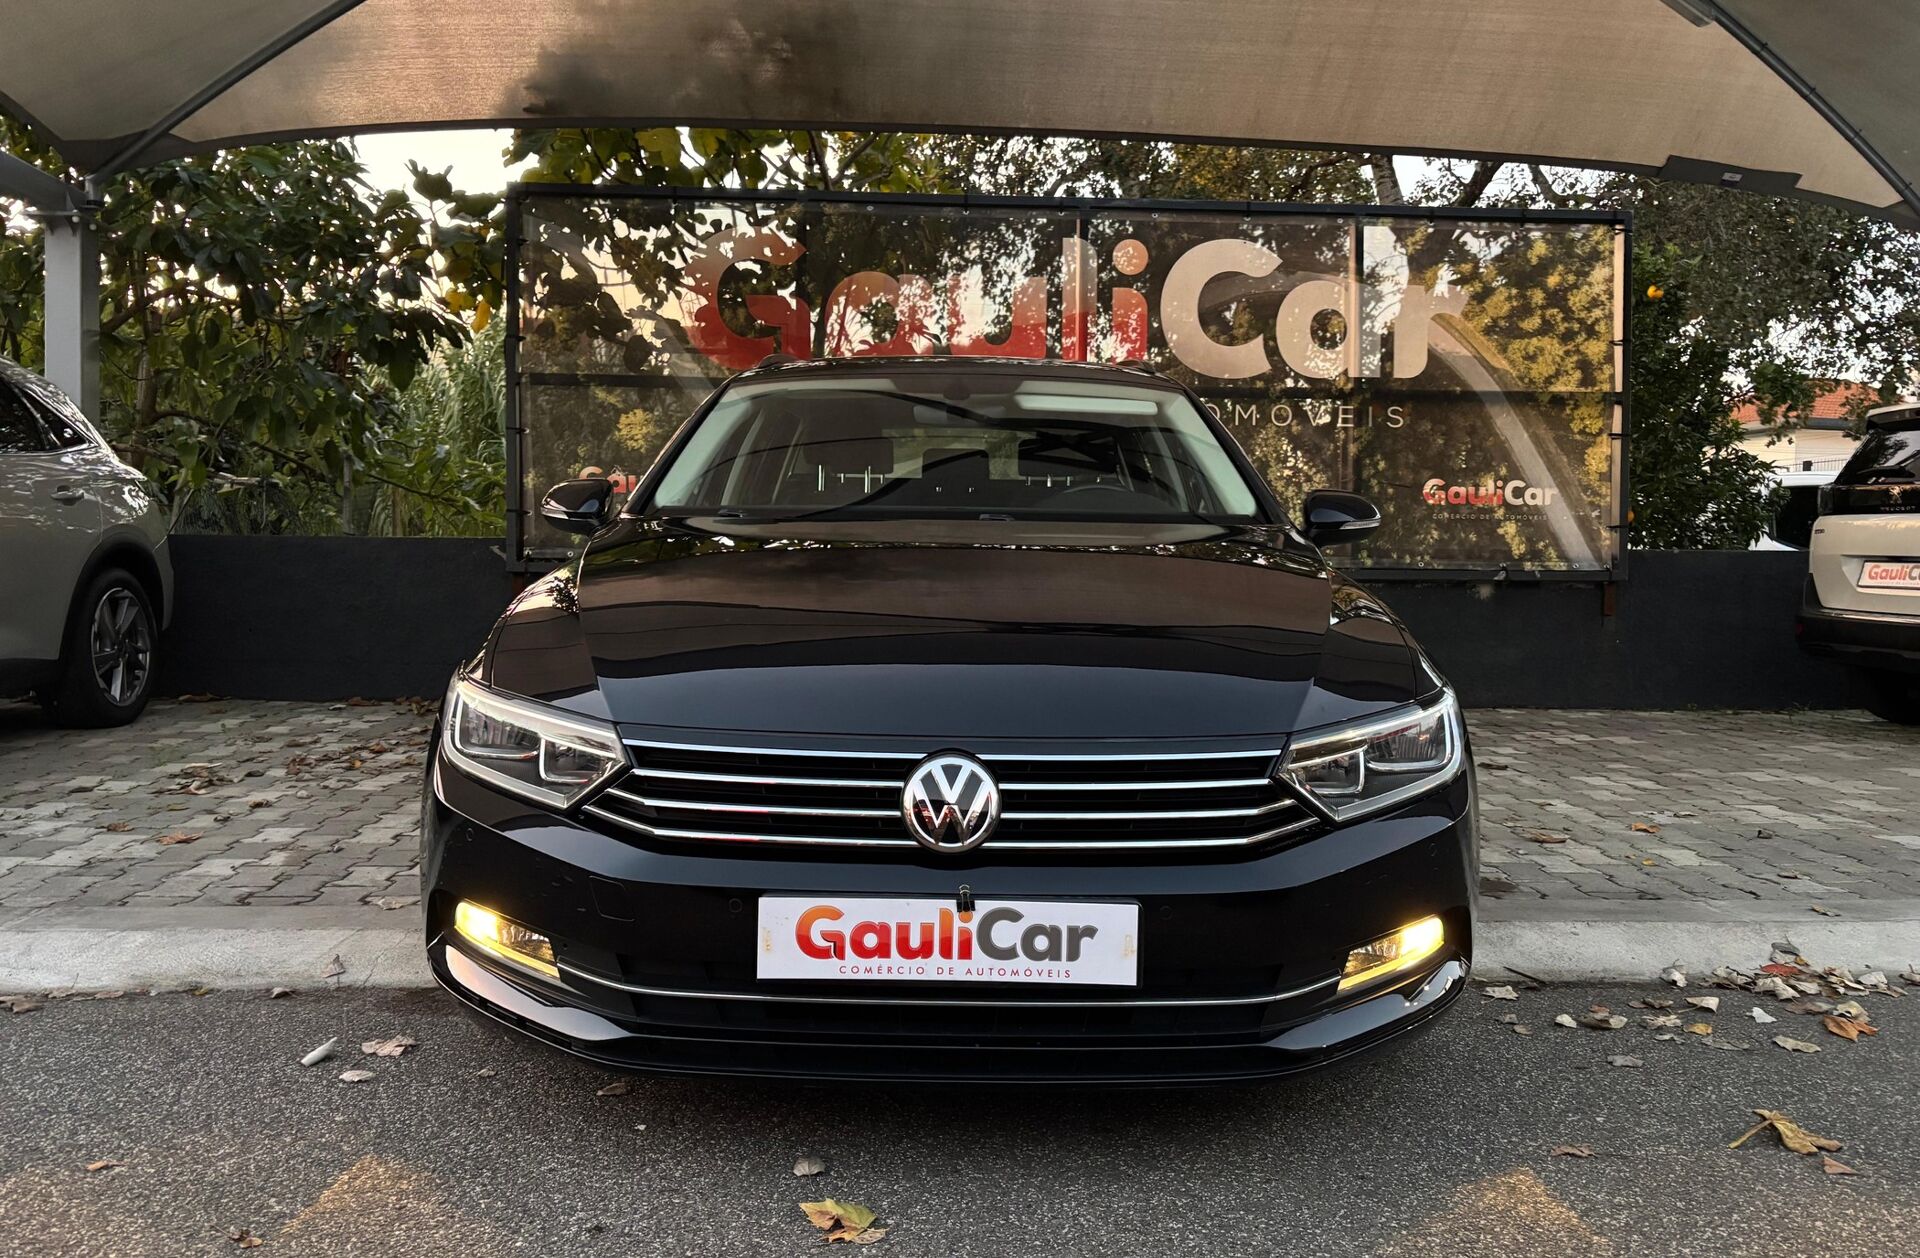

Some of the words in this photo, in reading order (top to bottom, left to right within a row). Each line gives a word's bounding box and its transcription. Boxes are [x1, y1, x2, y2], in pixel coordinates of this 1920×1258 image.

[681, 226, 1470, 380] GauliCar
[1422, 478, 1559, 505] GauliCar
[1868, 564, 1920, 580] GauliC
[795, 905, 1098, 961] GauliCar
[839, 964, 925, 976] COMÉRCIO
[936, 967, 955, 976] DE
[965, 966, 1072, 979] AUTOMÓVEIS
